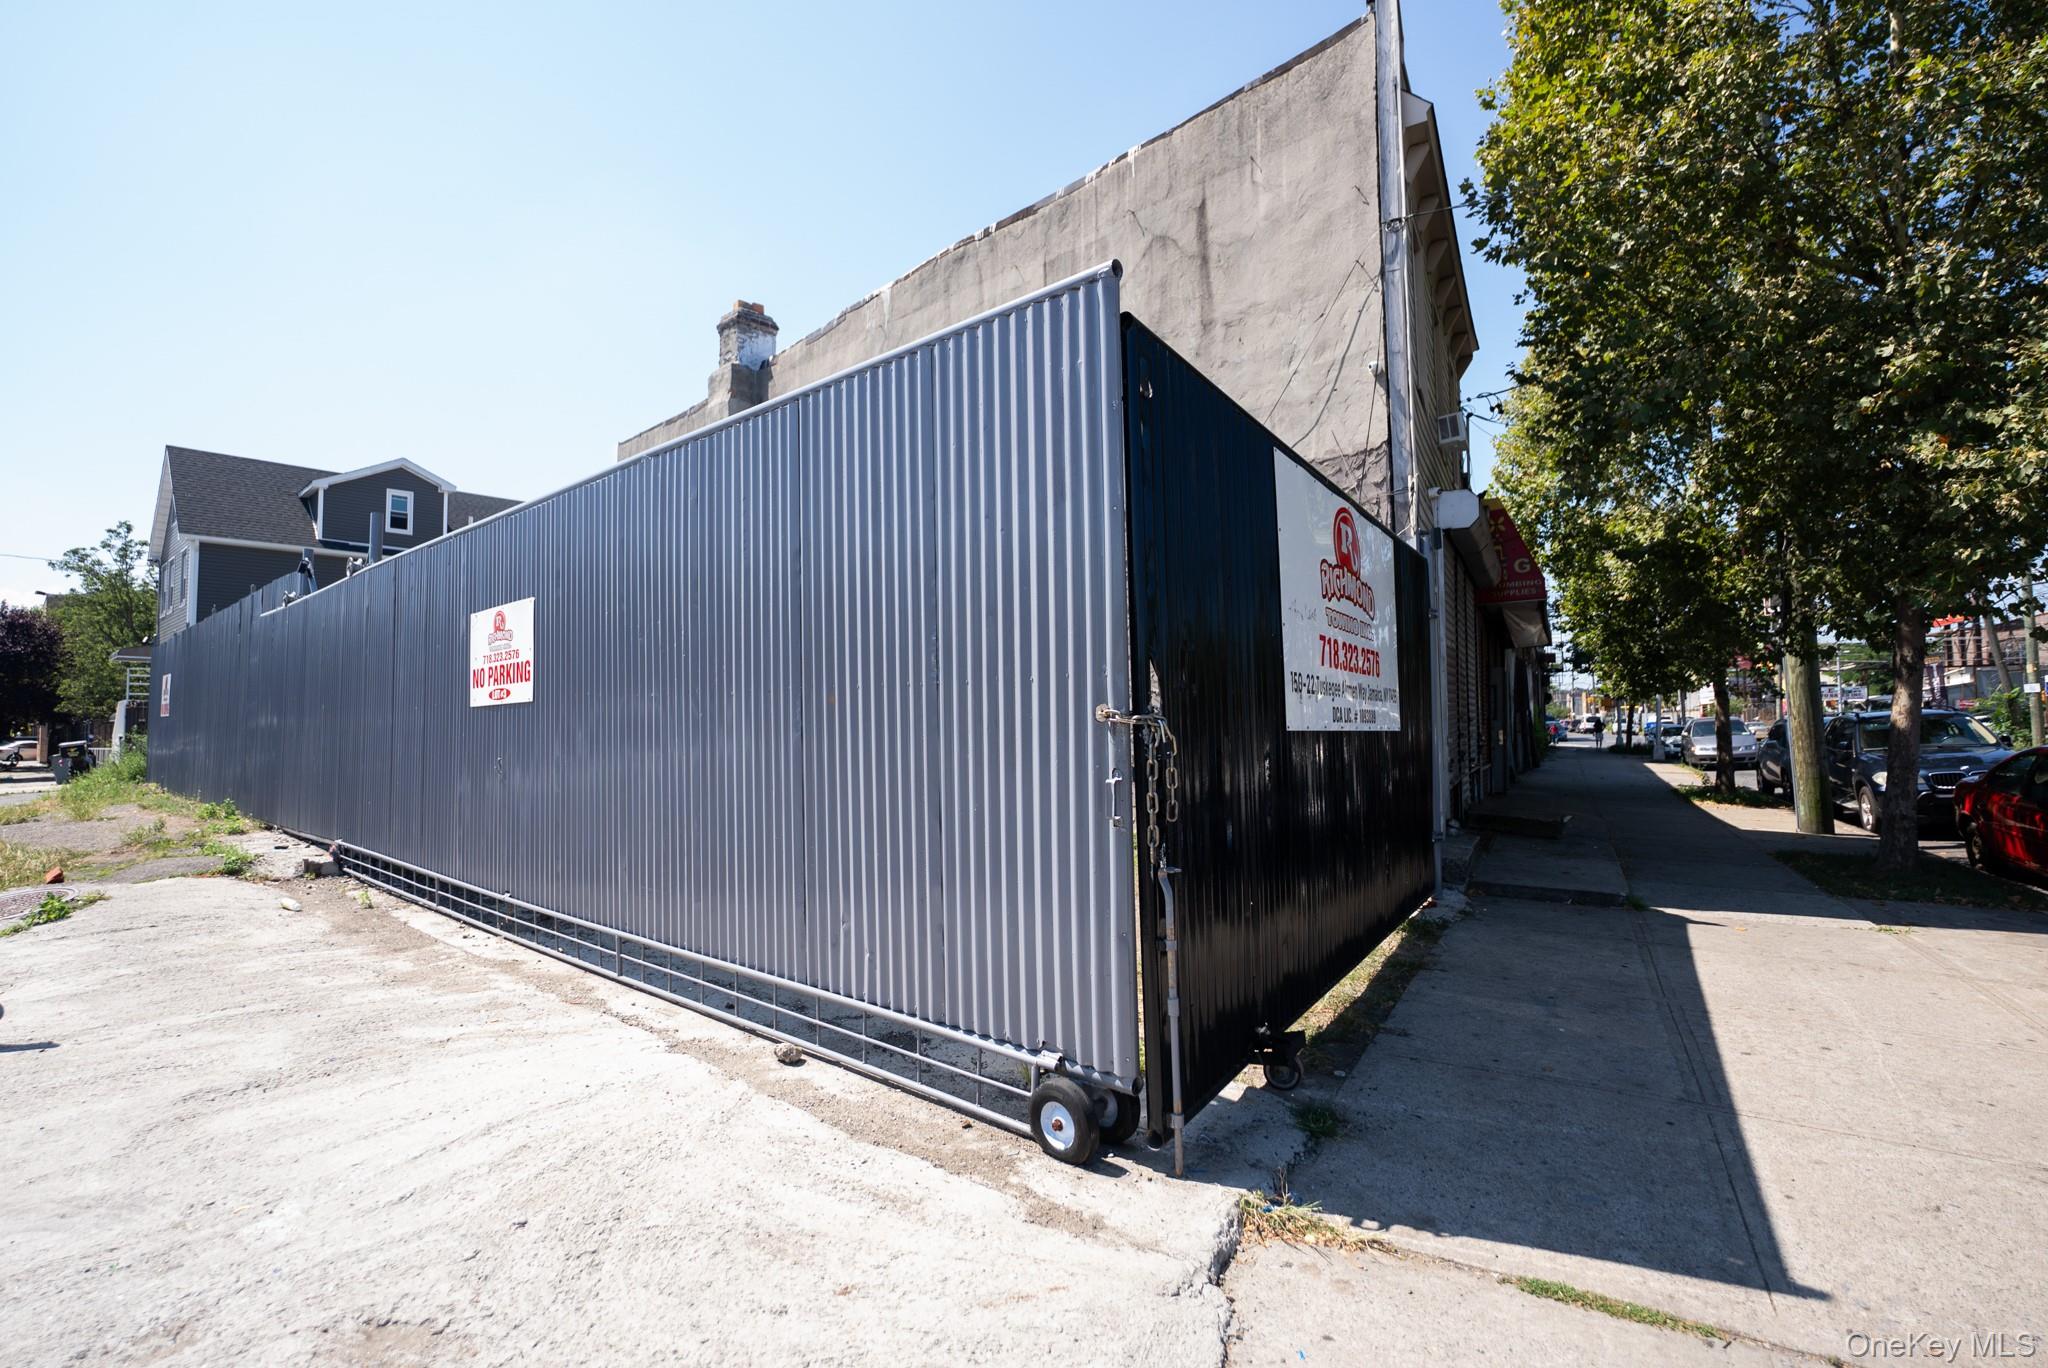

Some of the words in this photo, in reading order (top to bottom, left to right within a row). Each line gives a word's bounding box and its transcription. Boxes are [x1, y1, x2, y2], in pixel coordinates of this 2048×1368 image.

[1339, 521, 1359, 574] R
[1514, 558, 1531, 574] G
[1320, 558, 1375, 621] RICHMOND
[1325, 606, 1359, 636] TOWING
[483, 649, 520, 665] 718.323.2576
[1319, 634, 1381, 679] 718.323.2576
[472, 667, 485, 689] NO
[488, 660, 531, 687] PARKING
[1316, 675, 1341, 702] Tuskegee
[1358, 683, 1367, 704] Way
[1332, 706, 1343, 723] DCA
[1353, 709, 1359, 723] #
